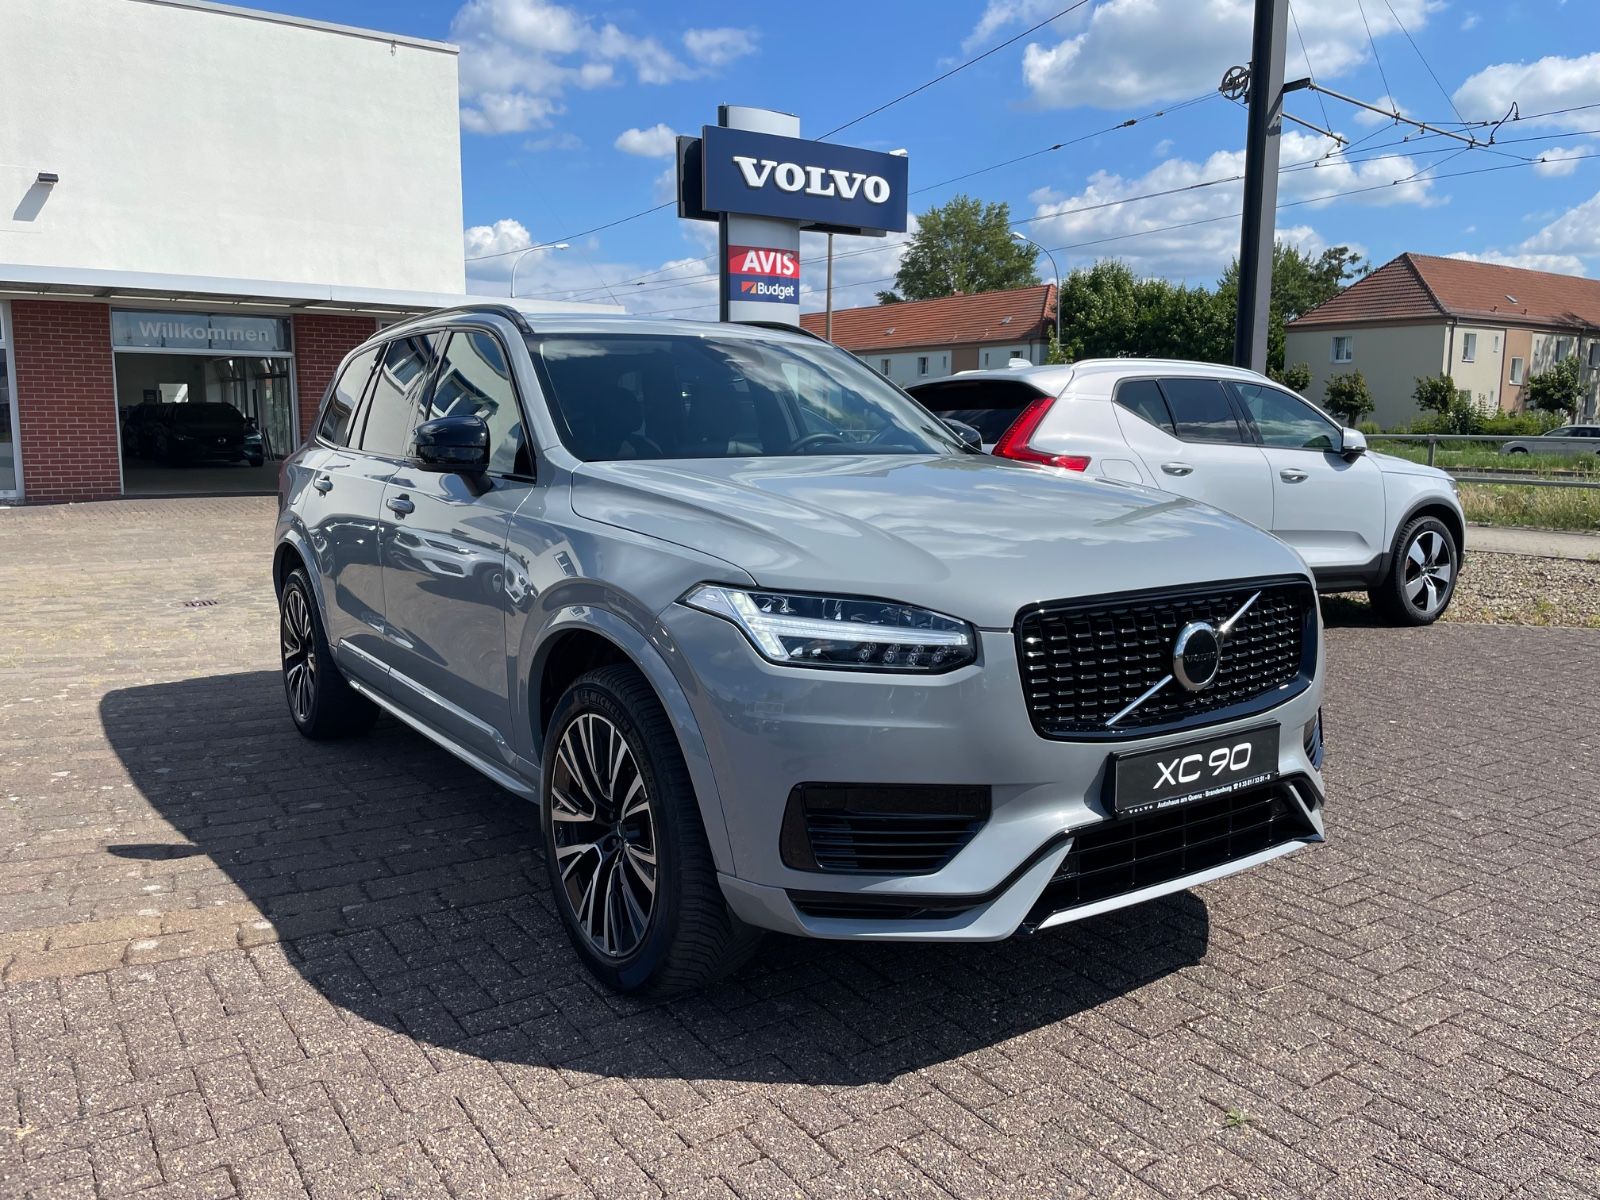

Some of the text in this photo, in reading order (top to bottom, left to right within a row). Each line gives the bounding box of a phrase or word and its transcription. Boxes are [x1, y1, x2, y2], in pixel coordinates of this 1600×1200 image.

[732, 156, 890, 204] VOLVO
[741, 250, 795, 275] AVIS
[757, 282, 795, 299] Budget
[138, 320, 269, 342] Willkommen
[1152, 742, 1252, 790] XC 90
